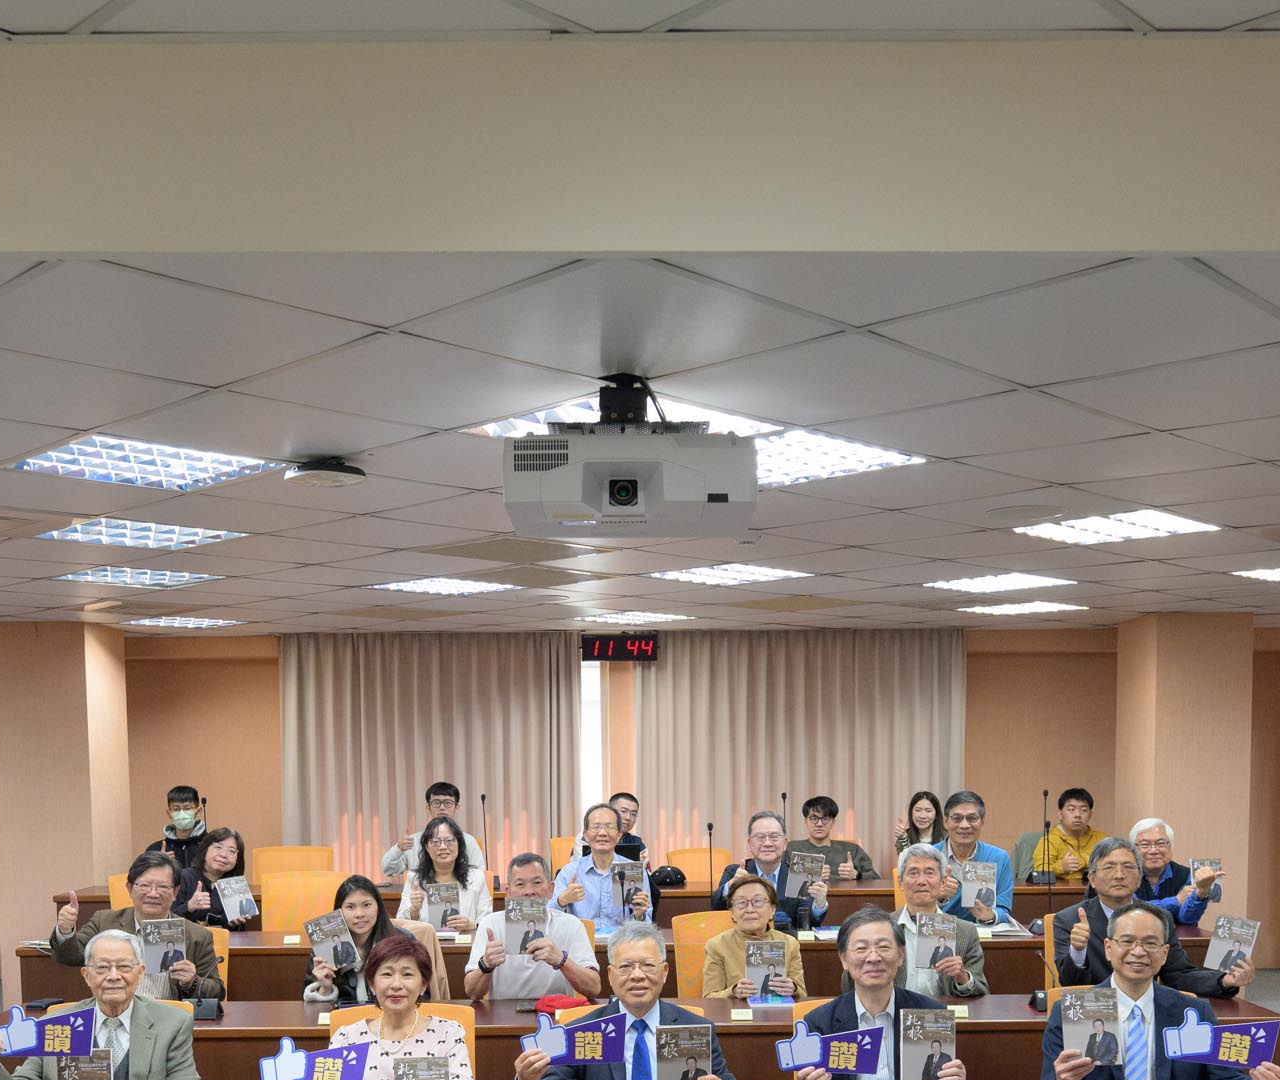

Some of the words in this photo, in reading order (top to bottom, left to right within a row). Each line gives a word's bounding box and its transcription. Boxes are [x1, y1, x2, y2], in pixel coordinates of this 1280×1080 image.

[593, 639, 614, 657] 11
[626, 639, 654, 657] 44
[44, 1024, 71, 1054] 讚
[574, 1031, 603, 1060] 讚
[1217, 1031, 1251, 1065] 讚
[828, 1041, 858, 1071] 讚
